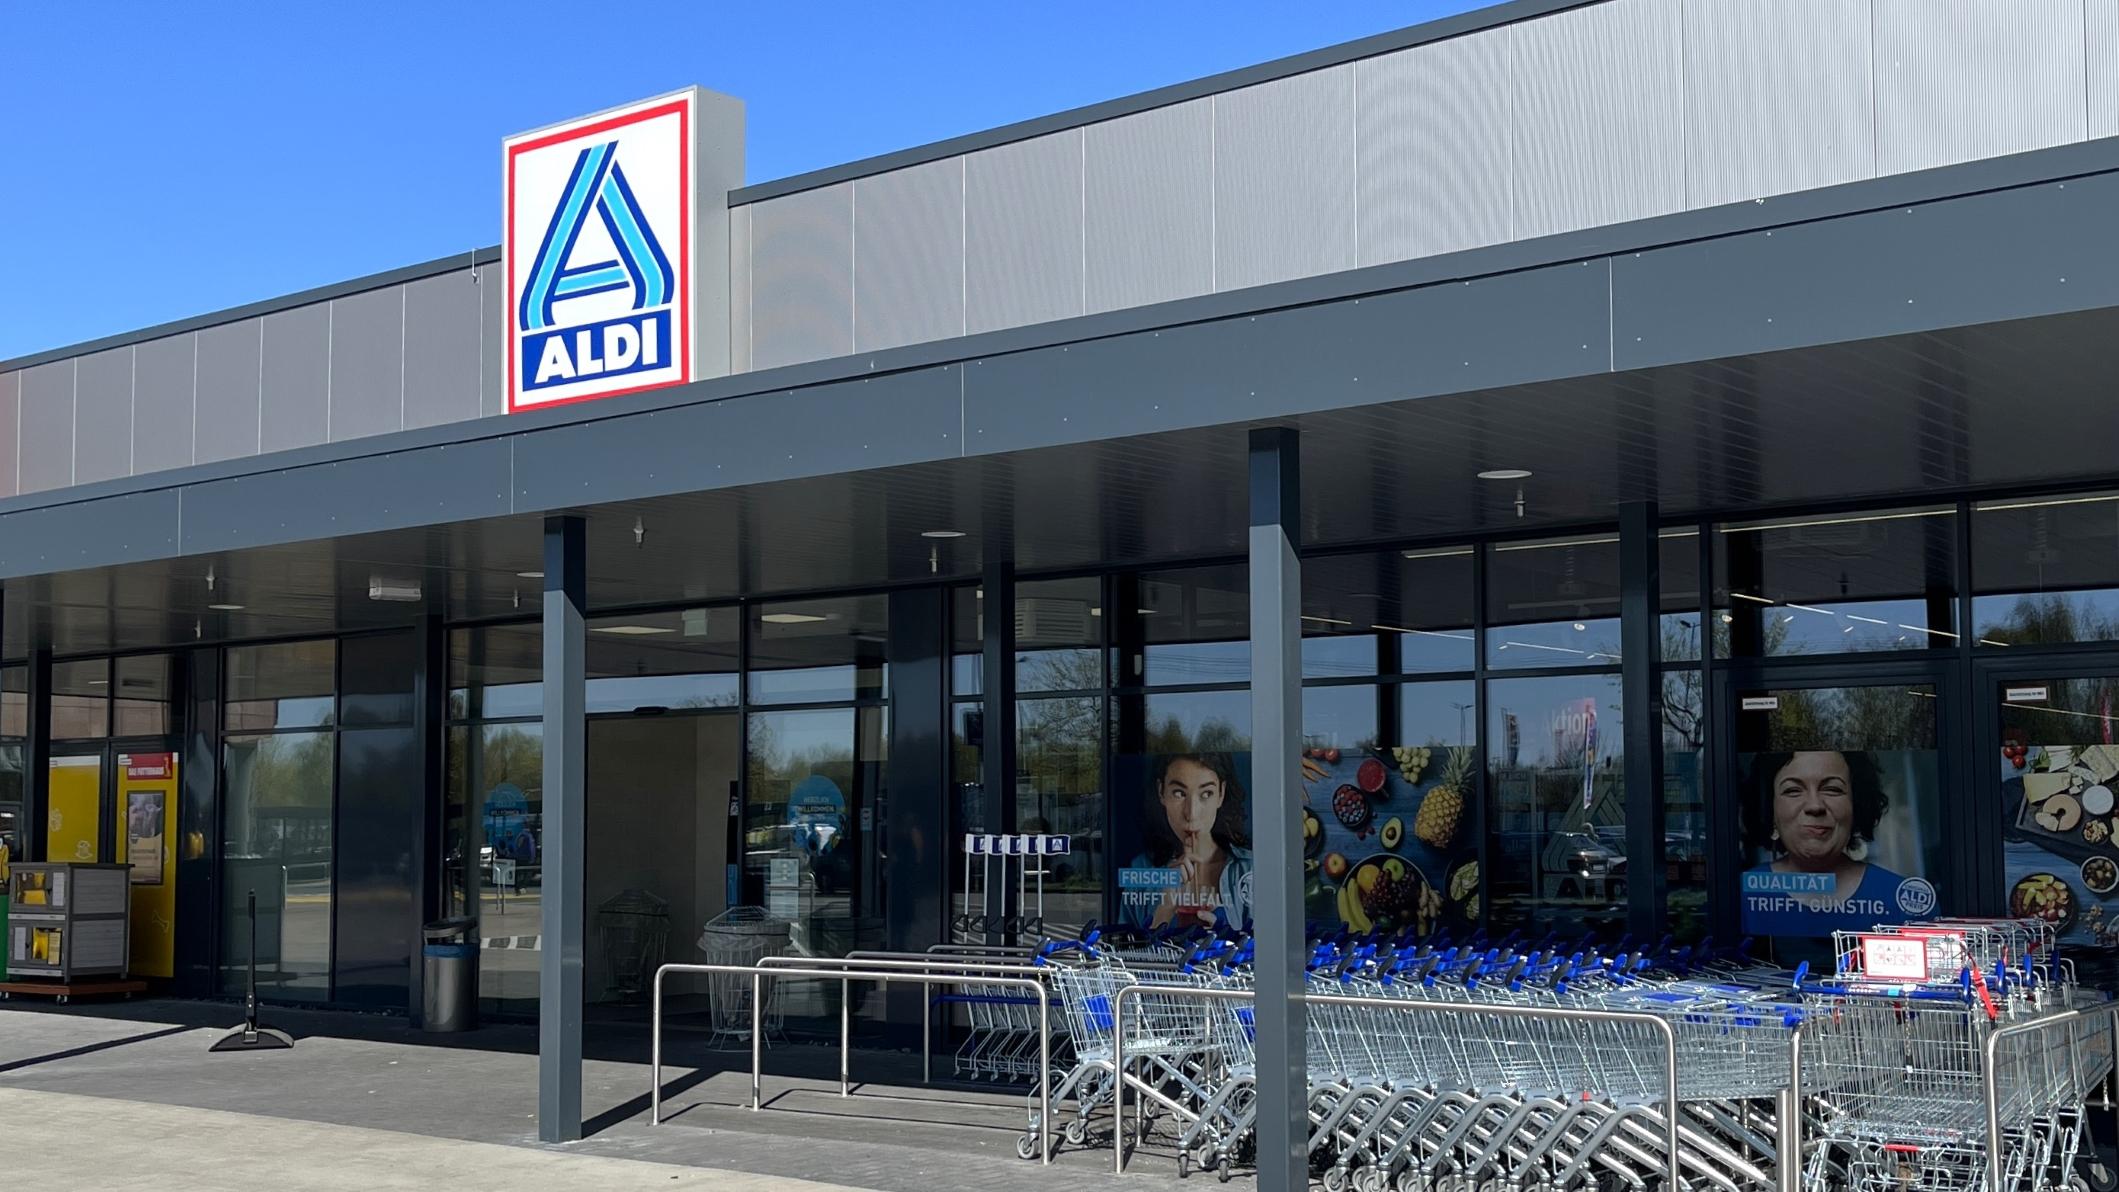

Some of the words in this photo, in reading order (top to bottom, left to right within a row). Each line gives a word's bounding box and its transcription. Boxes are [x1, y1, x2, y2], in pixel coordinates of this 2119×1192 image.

[534, 317, 658, 384] ALDI
[1122, 871, 1177, 885] FRISCHE
[1747, 873, 1828, 891] QUALITÄT
[1122, 891, 1166, 906] TRIFFT
[1747, 897, 1803, 912] TRIFFT
[1810, 895, 1889, 915] GÜNSTIG.
[1900, 889, 1931, 905] ALDI
